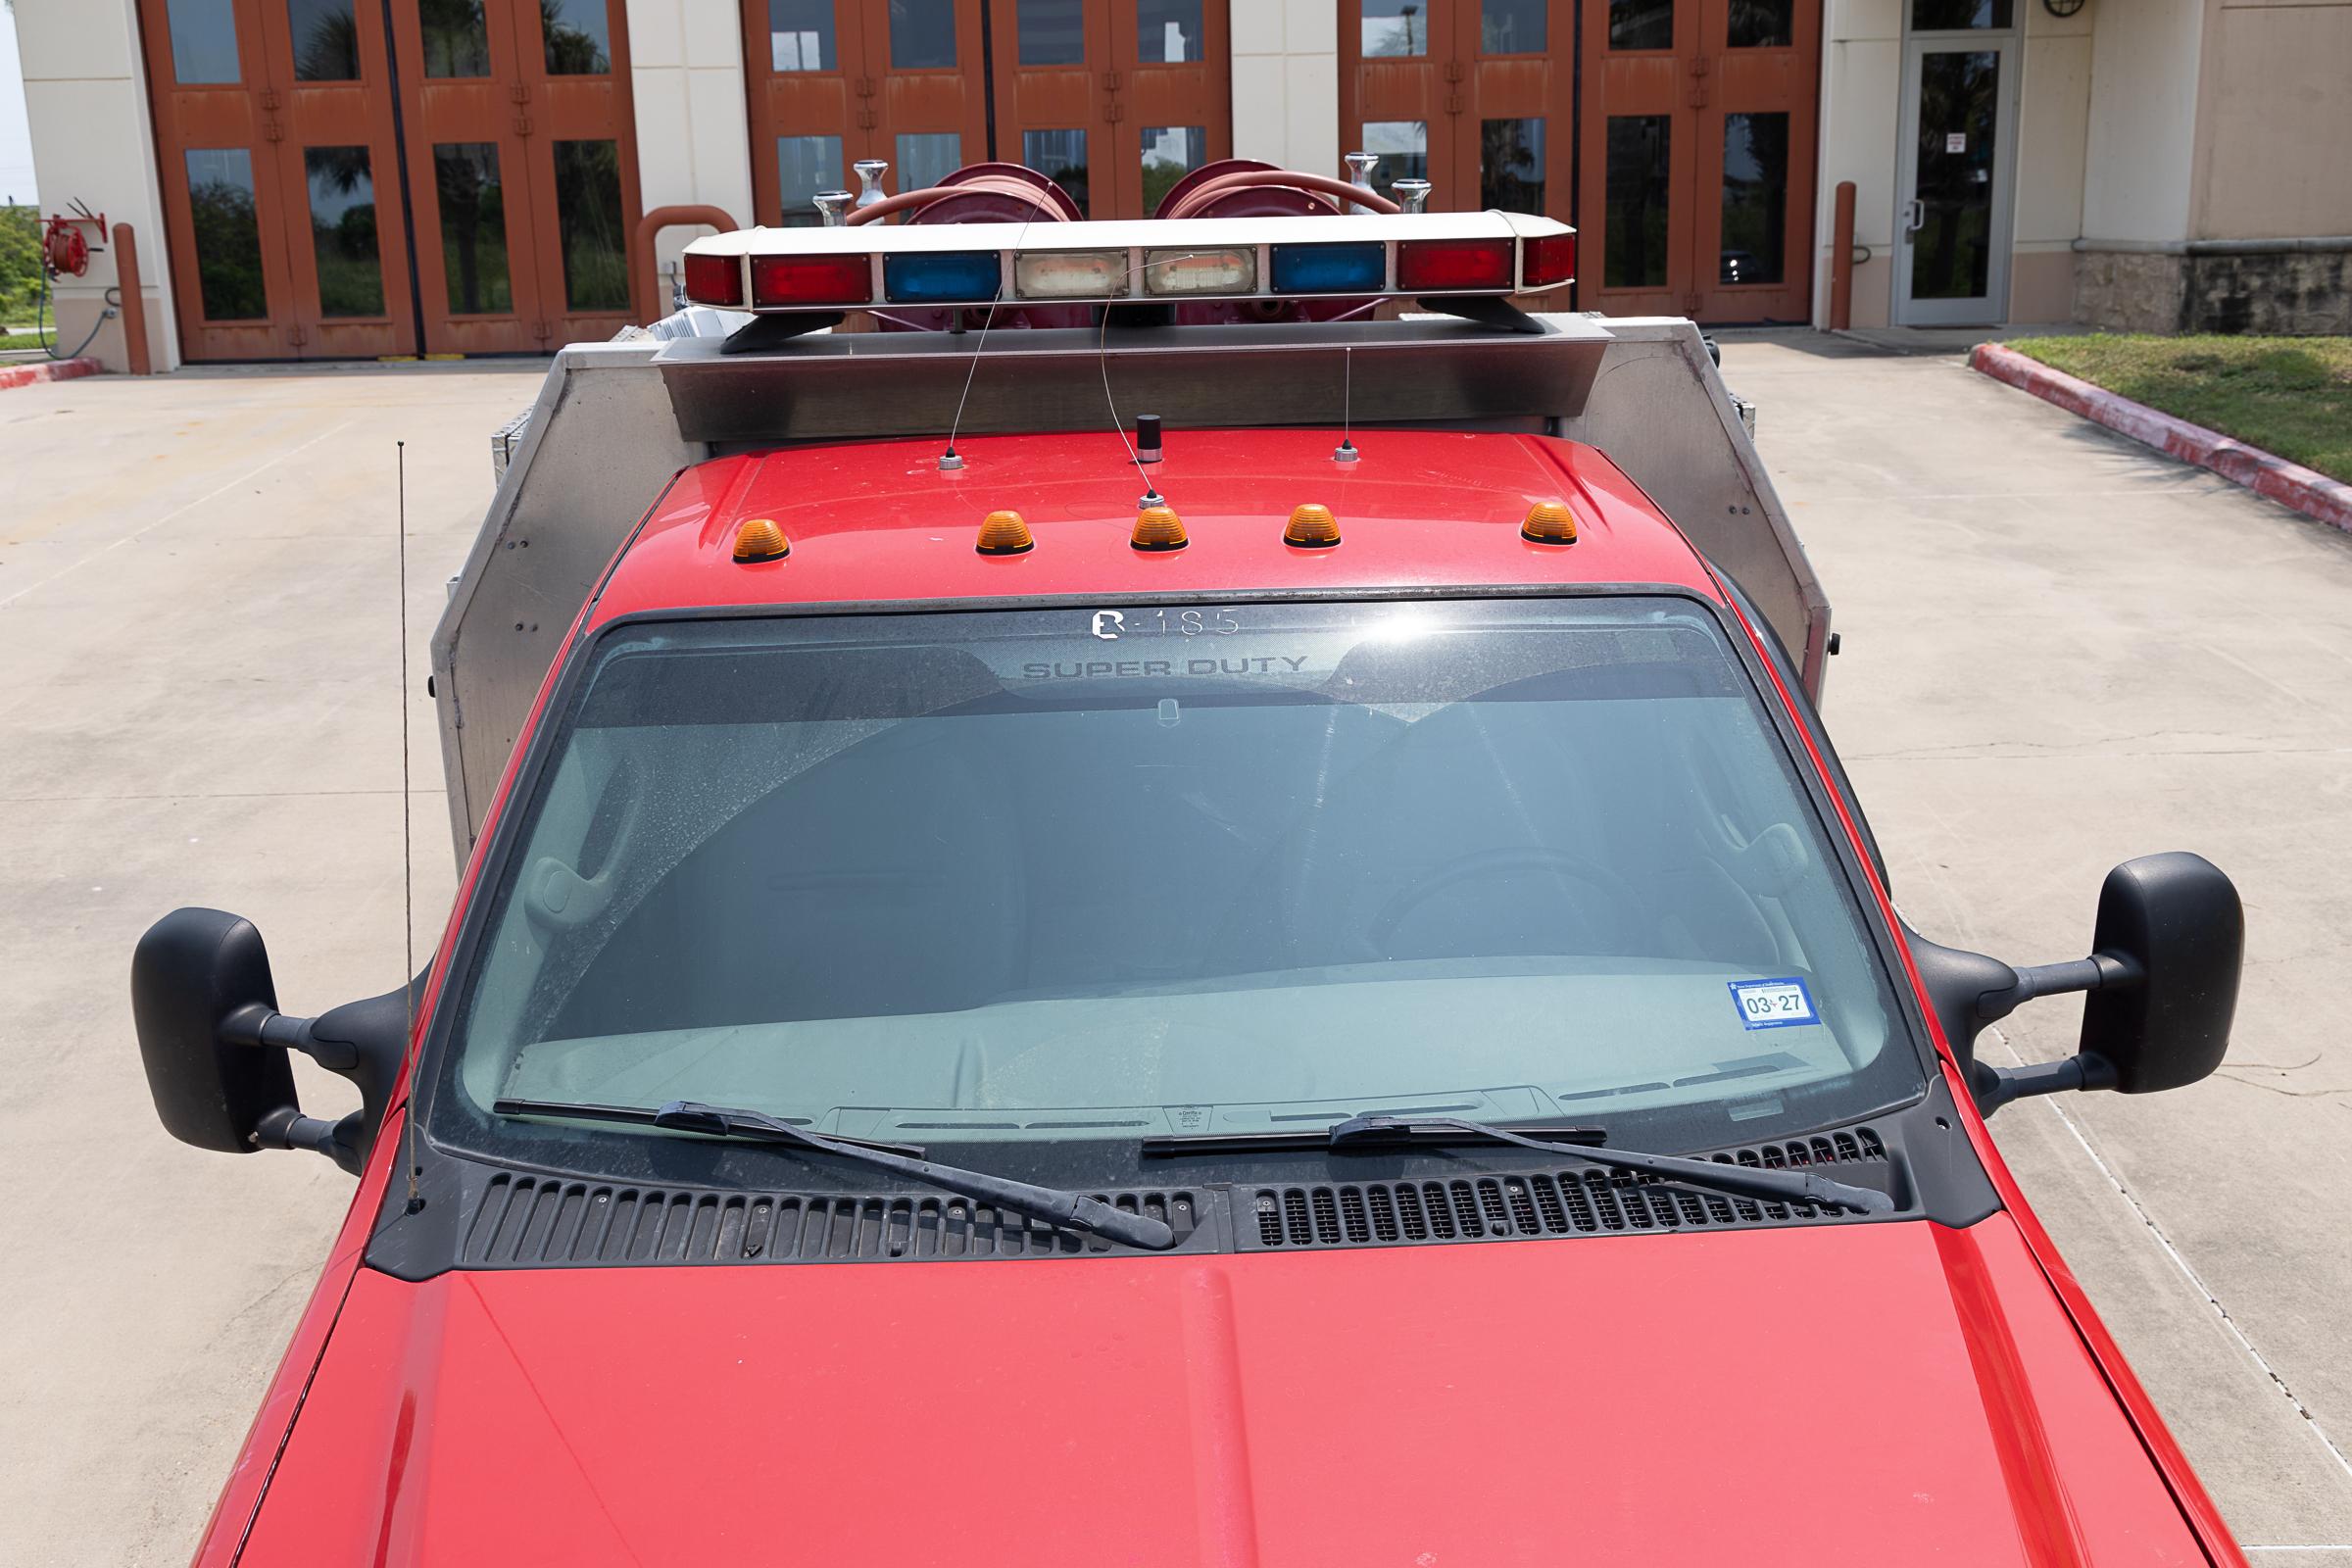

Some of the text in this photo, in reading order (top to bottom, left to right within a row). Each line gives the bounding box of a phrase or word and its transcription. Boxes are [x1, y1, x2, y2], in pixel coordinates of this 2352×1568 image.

[1022, 655, 1308, 679] SUPER DUTY
[1745, 994, 1800, 1014] 03 27
